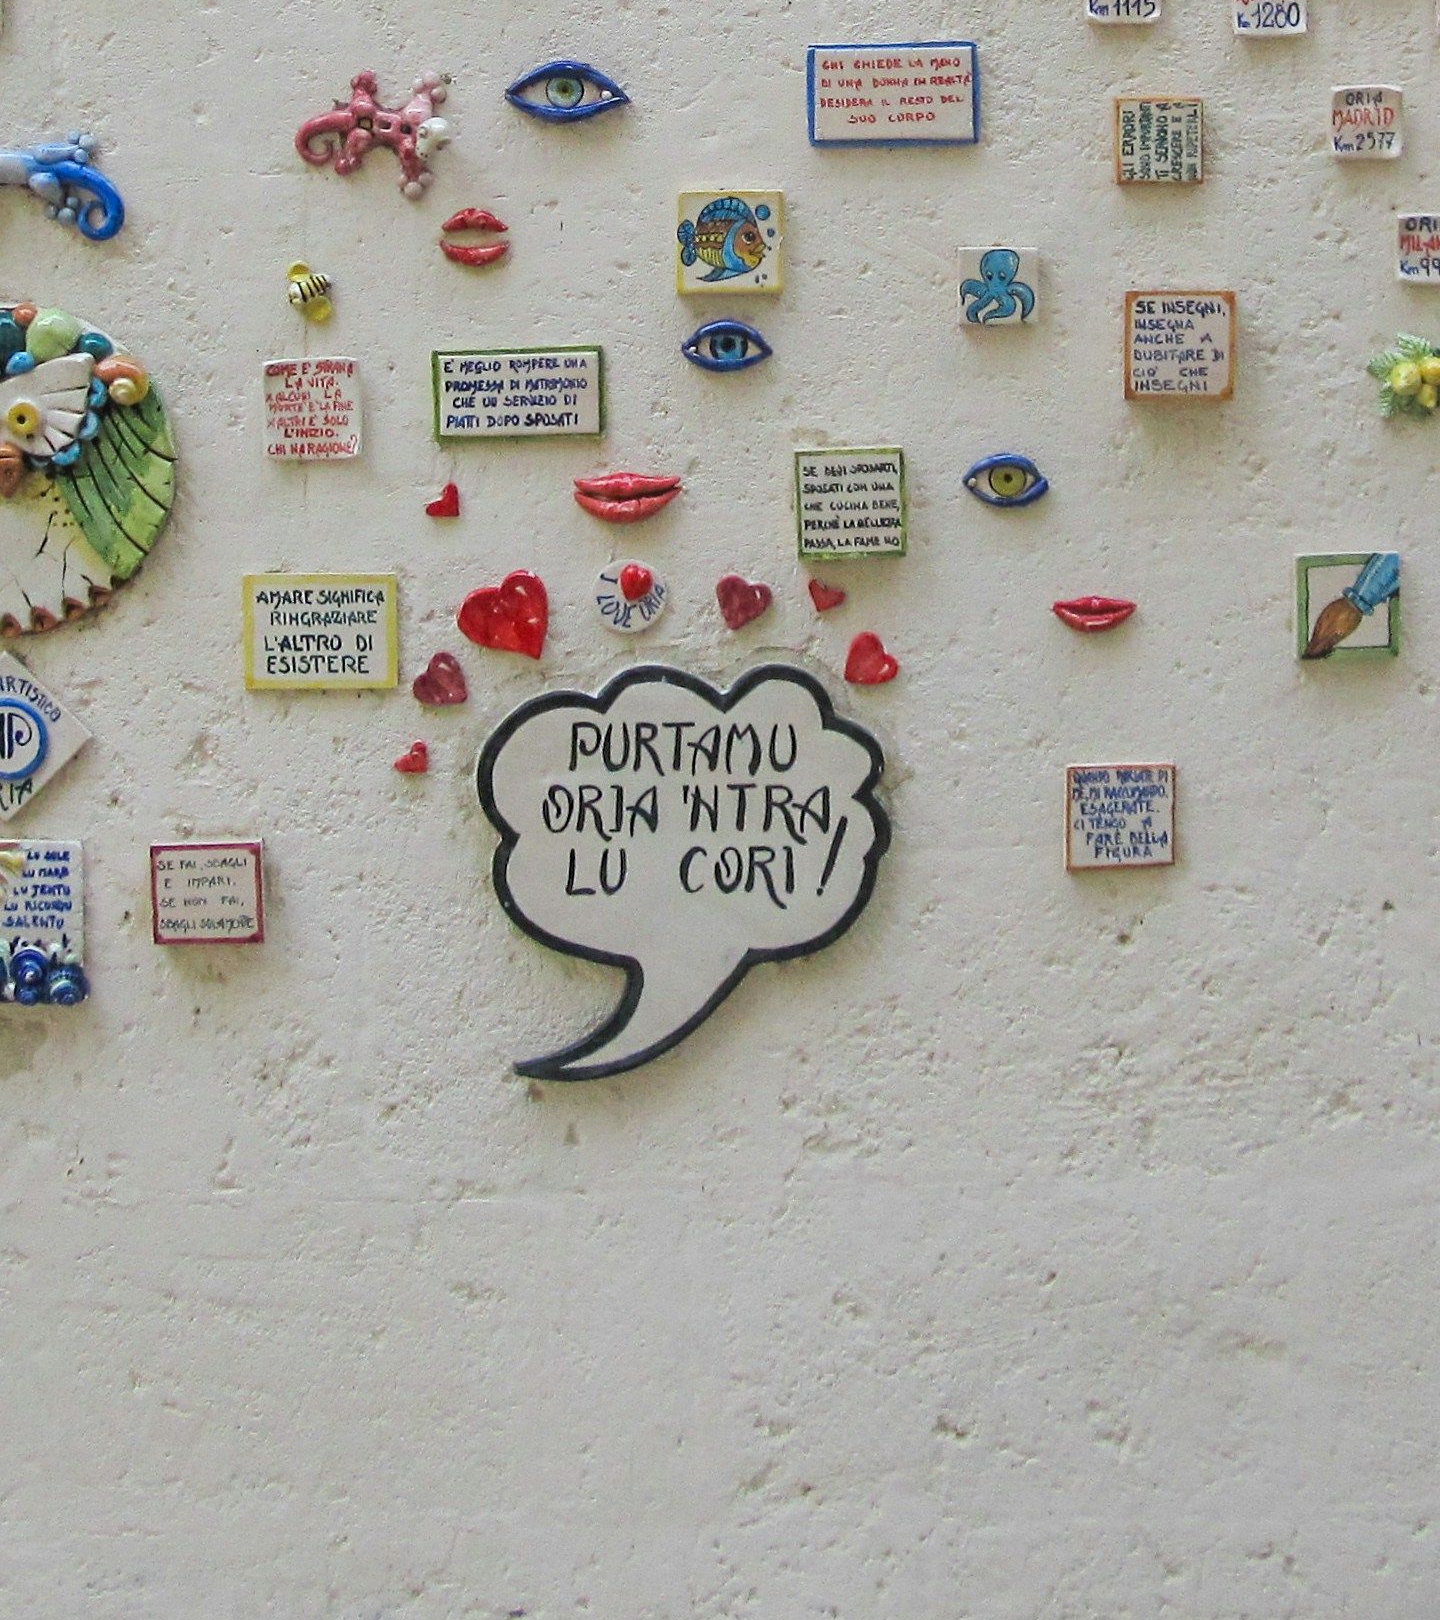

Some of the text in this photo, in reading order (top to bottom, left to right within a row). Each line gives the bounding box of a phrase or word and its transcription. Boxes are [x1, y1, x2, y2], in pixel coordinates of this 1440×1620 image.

[1346, 91, 1383, 106] ORIA
[1332, 108, 1395, 128] MADRID
[1135, 301, 1226, 316] SE INSEGNI,
[1134, 319, 1194, 331] INSEGNA
[1134, 334, 1184, 344] ANCHE
[1134, 349, 1224, 363] DUBITARE DI
[460, 361, 501, 374] MEGLIO
[510, 360, 559, 373] ROMPERE
[1179, 368, 1208, 377] CHE
[445, 380, 504, 394] PROMESSA
[510, 380, 521, 391] DI
[1134, 380, 1208, 392] INSEGNI
[453, 396, 476, 407] CHE
[565, 395, 577, 406] DI
[447, 413, 579, 428] PIATTI DOPO SPOSATI
[257, 589, 385, 607] AMARE SIGNIFICA
[270, 610, 378, 627] RINGRAZIARE
[265, 633, 373, 653] L'ALTRO DI
[267, 655, 369, 674] ESISTERE
[569, 722, 799, 775] PURTAMU
[542, 782, 836, 846] ORIA 'NTRA
[567, 848, 628, 897] LU
